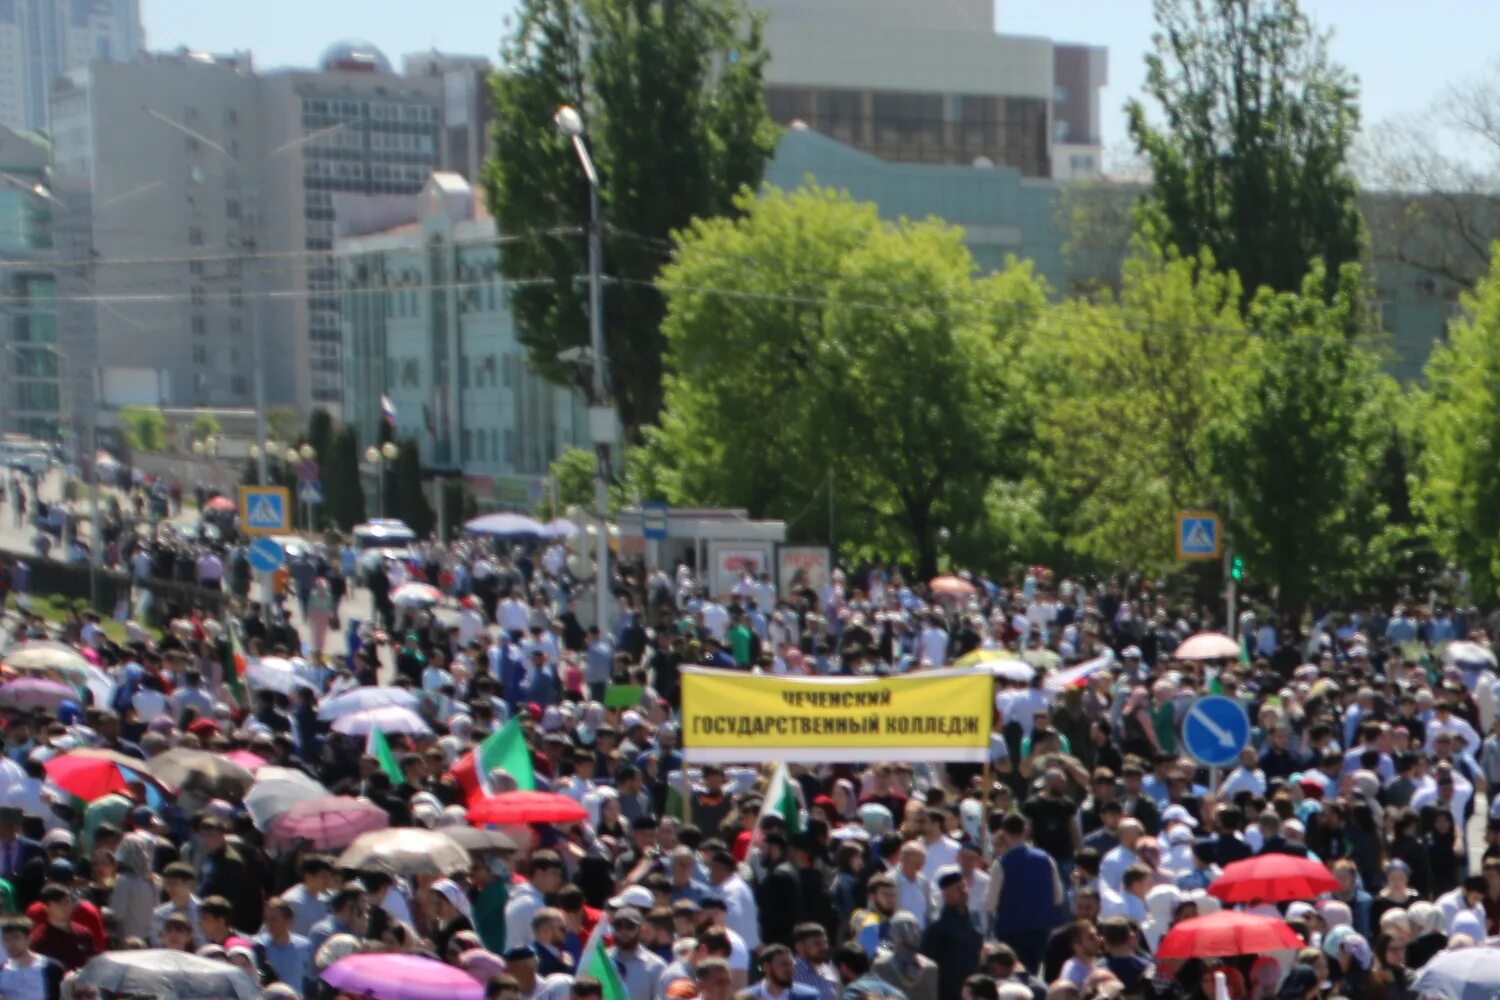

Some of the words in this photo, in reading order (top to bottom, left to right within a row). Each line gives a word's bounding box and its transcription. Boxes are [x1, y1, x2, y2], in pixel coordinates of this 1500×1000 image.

[782, 689, 892, 709] ЧЕЧЕНСКИЙ
[692, 715, 880, 736] ГОСУДАРСТВЕННЫЙ
[886, 714, 979, 736] КОЛЛЕДЖ
